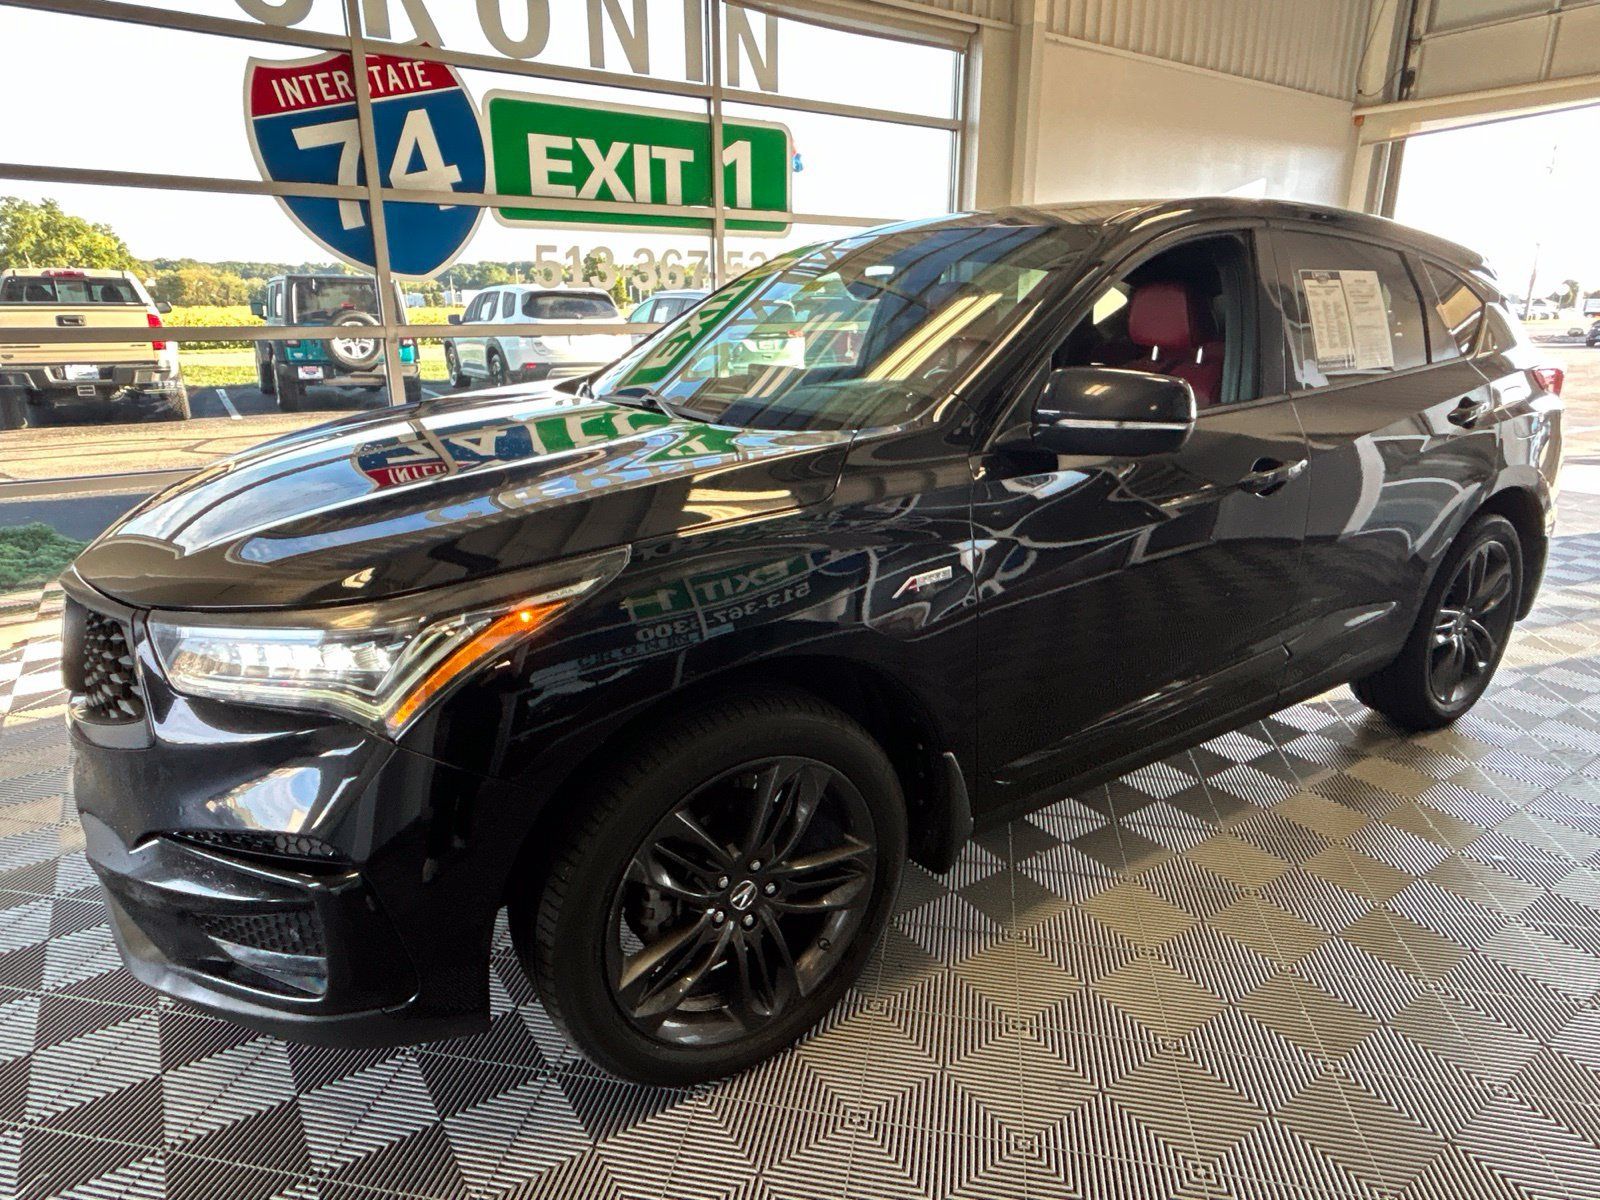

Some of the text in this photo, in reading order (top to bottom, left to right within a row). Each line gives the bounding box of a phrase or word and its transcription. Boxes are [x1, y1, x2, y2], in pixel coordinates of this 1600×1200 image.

[234, 0, 779, 92] ONIN
[291, 108, 462, 230] 74
[527, 133, 751, 208] EXIT 1
